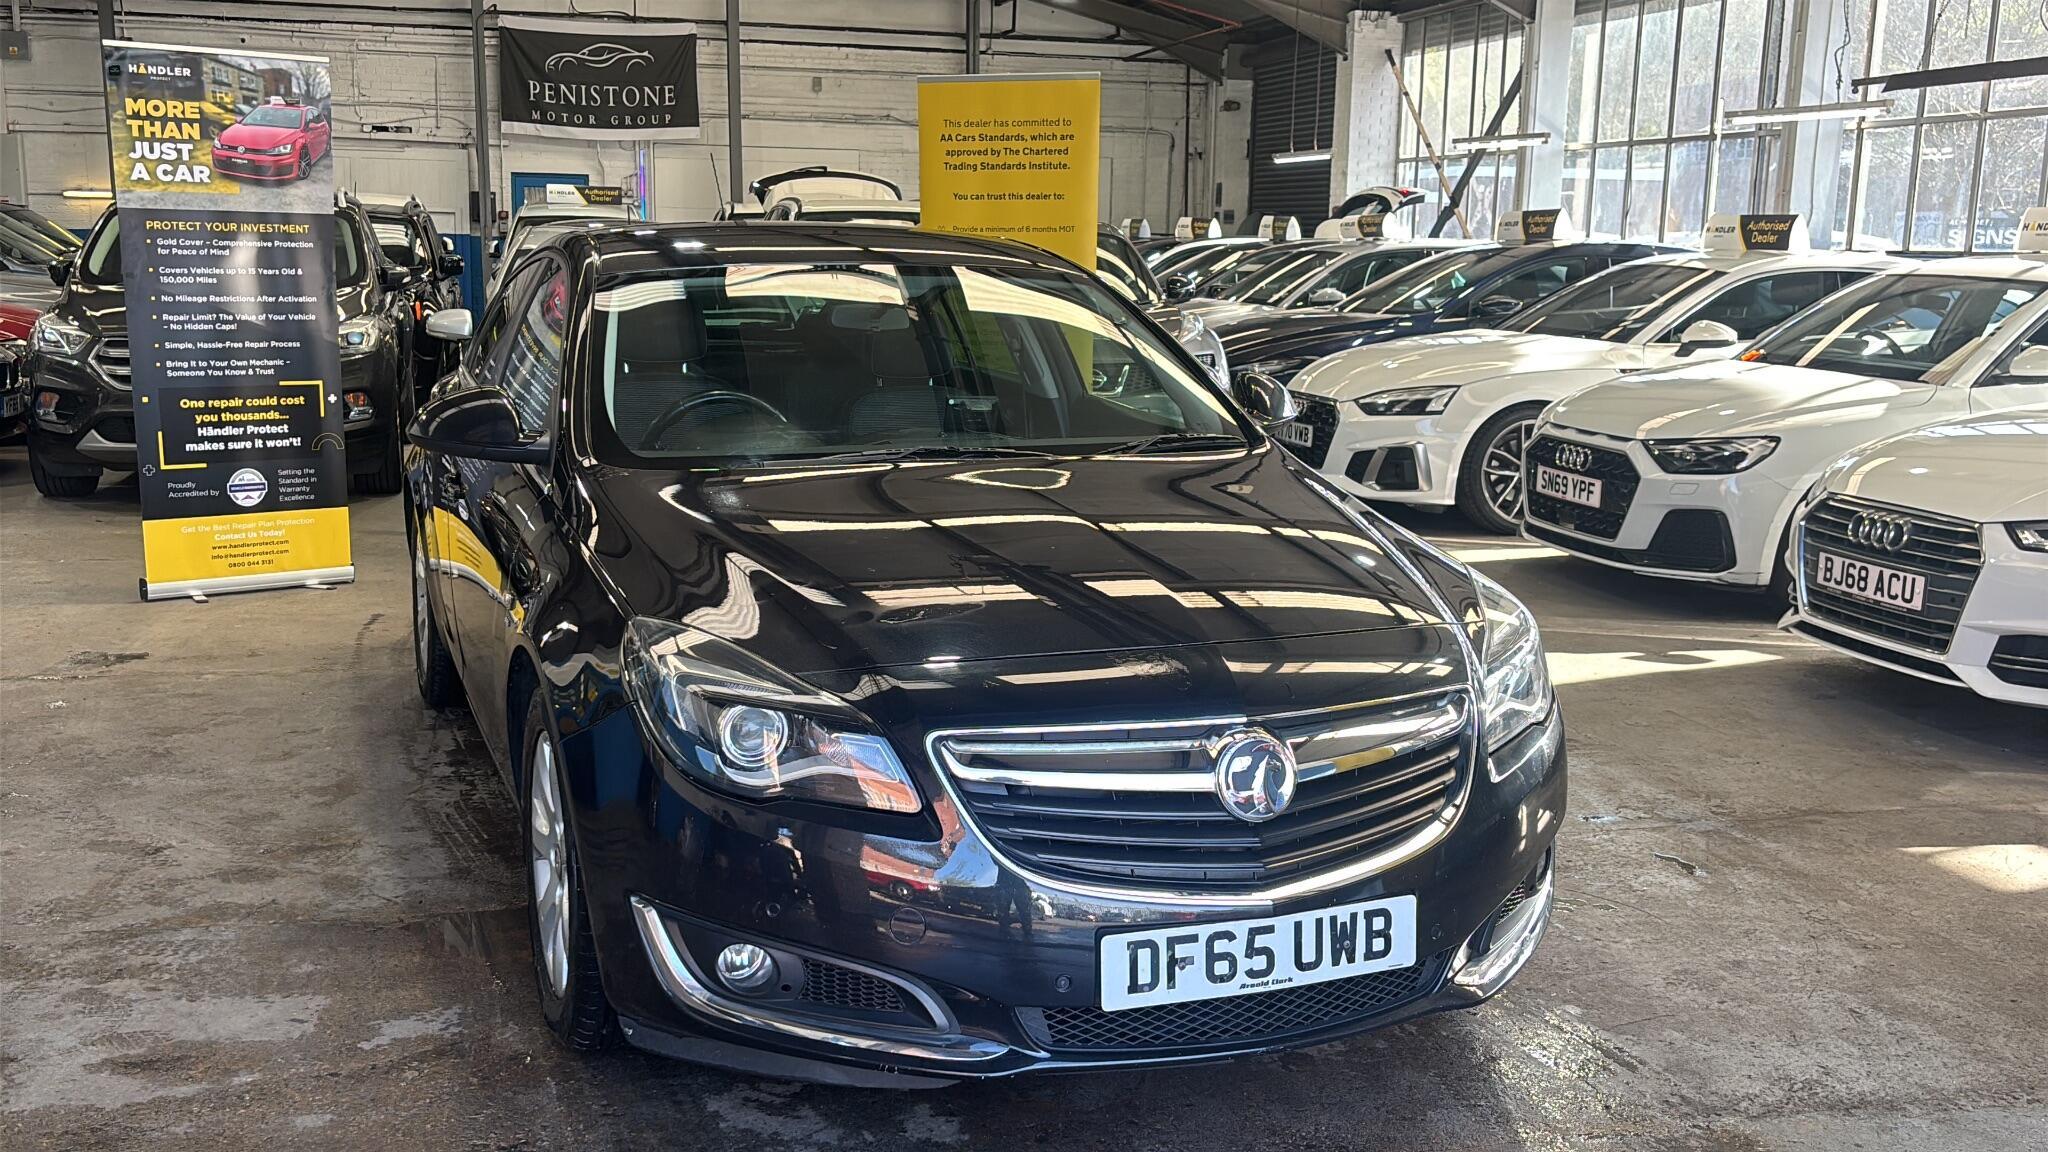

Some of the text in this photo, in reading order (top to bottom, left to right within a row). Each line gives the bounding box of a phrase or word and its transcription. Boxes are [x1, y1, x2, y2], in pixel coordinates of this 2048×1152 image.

[528, 80, 676, 107] PENISTONE
[125, 98, 200, 118] MORE
[532, 111, 672, 125] MOTOR GROUP
[943, 118, 1071, 128] This dealer has committed to
[126, 120, 200, 140] THAN
[940, 134, 953, 142] AA
[978, 133, 1028, 142] Standards,
[130, 141, 193, 161] JUST
[945, 147, 1069, 157] approved by The Chartered
[944, 161, 1070, 172] Trading Standards Institute.
[130, 163, 211, 183] A CAR
[1008, 192, 1023, 200] this
[1025, 192, 1051, 200] dealer
[146, 221, 309, 233] PROTECT YOUR INVESTMENT
[1747, 220, 1790, 231] Authorised
[1752, 232, 1778, 243] Dealer
[1948, 228, 2017, 246] SGNS
[213, 239, 272, 248] Comprehensive
[176, 295, 207, 303] Mileage
[163, 314, 189, 322] Repair
[166, 360, 188, 368] Bring
[180, 396, 305, 409] One repair could cost
[195, 410, 289, 424] you thousands...
[198, 424, 288, 436] Händler Protect
[186, 440, 224, 451] makes
[228, 440, 252, 449] sure
[255, 438, 263, 448] it
[1541, 470, 1595, 501] SN69 YPF
[169, 490, 208, 498] Accredited
[213, 524, 230, 532] Best
[233, 522, 256, 531] Repair
[277, 517, 315, 526] Protection
[215, 532, 245, 541] Contact
[260, 529, 286, 538] Today!
[212, 539, 289, 550] www.handlerprotect.com
[211, 549, 289, 560] info@handlerprotect.com
[1823, 556, 1869, 592] BJ68
[1874, 570, 1915, 603] ACU
[1127, 908, 1392, 995] DF65 UWB
[1239, 977, 1293, 989] Arnold Clark
